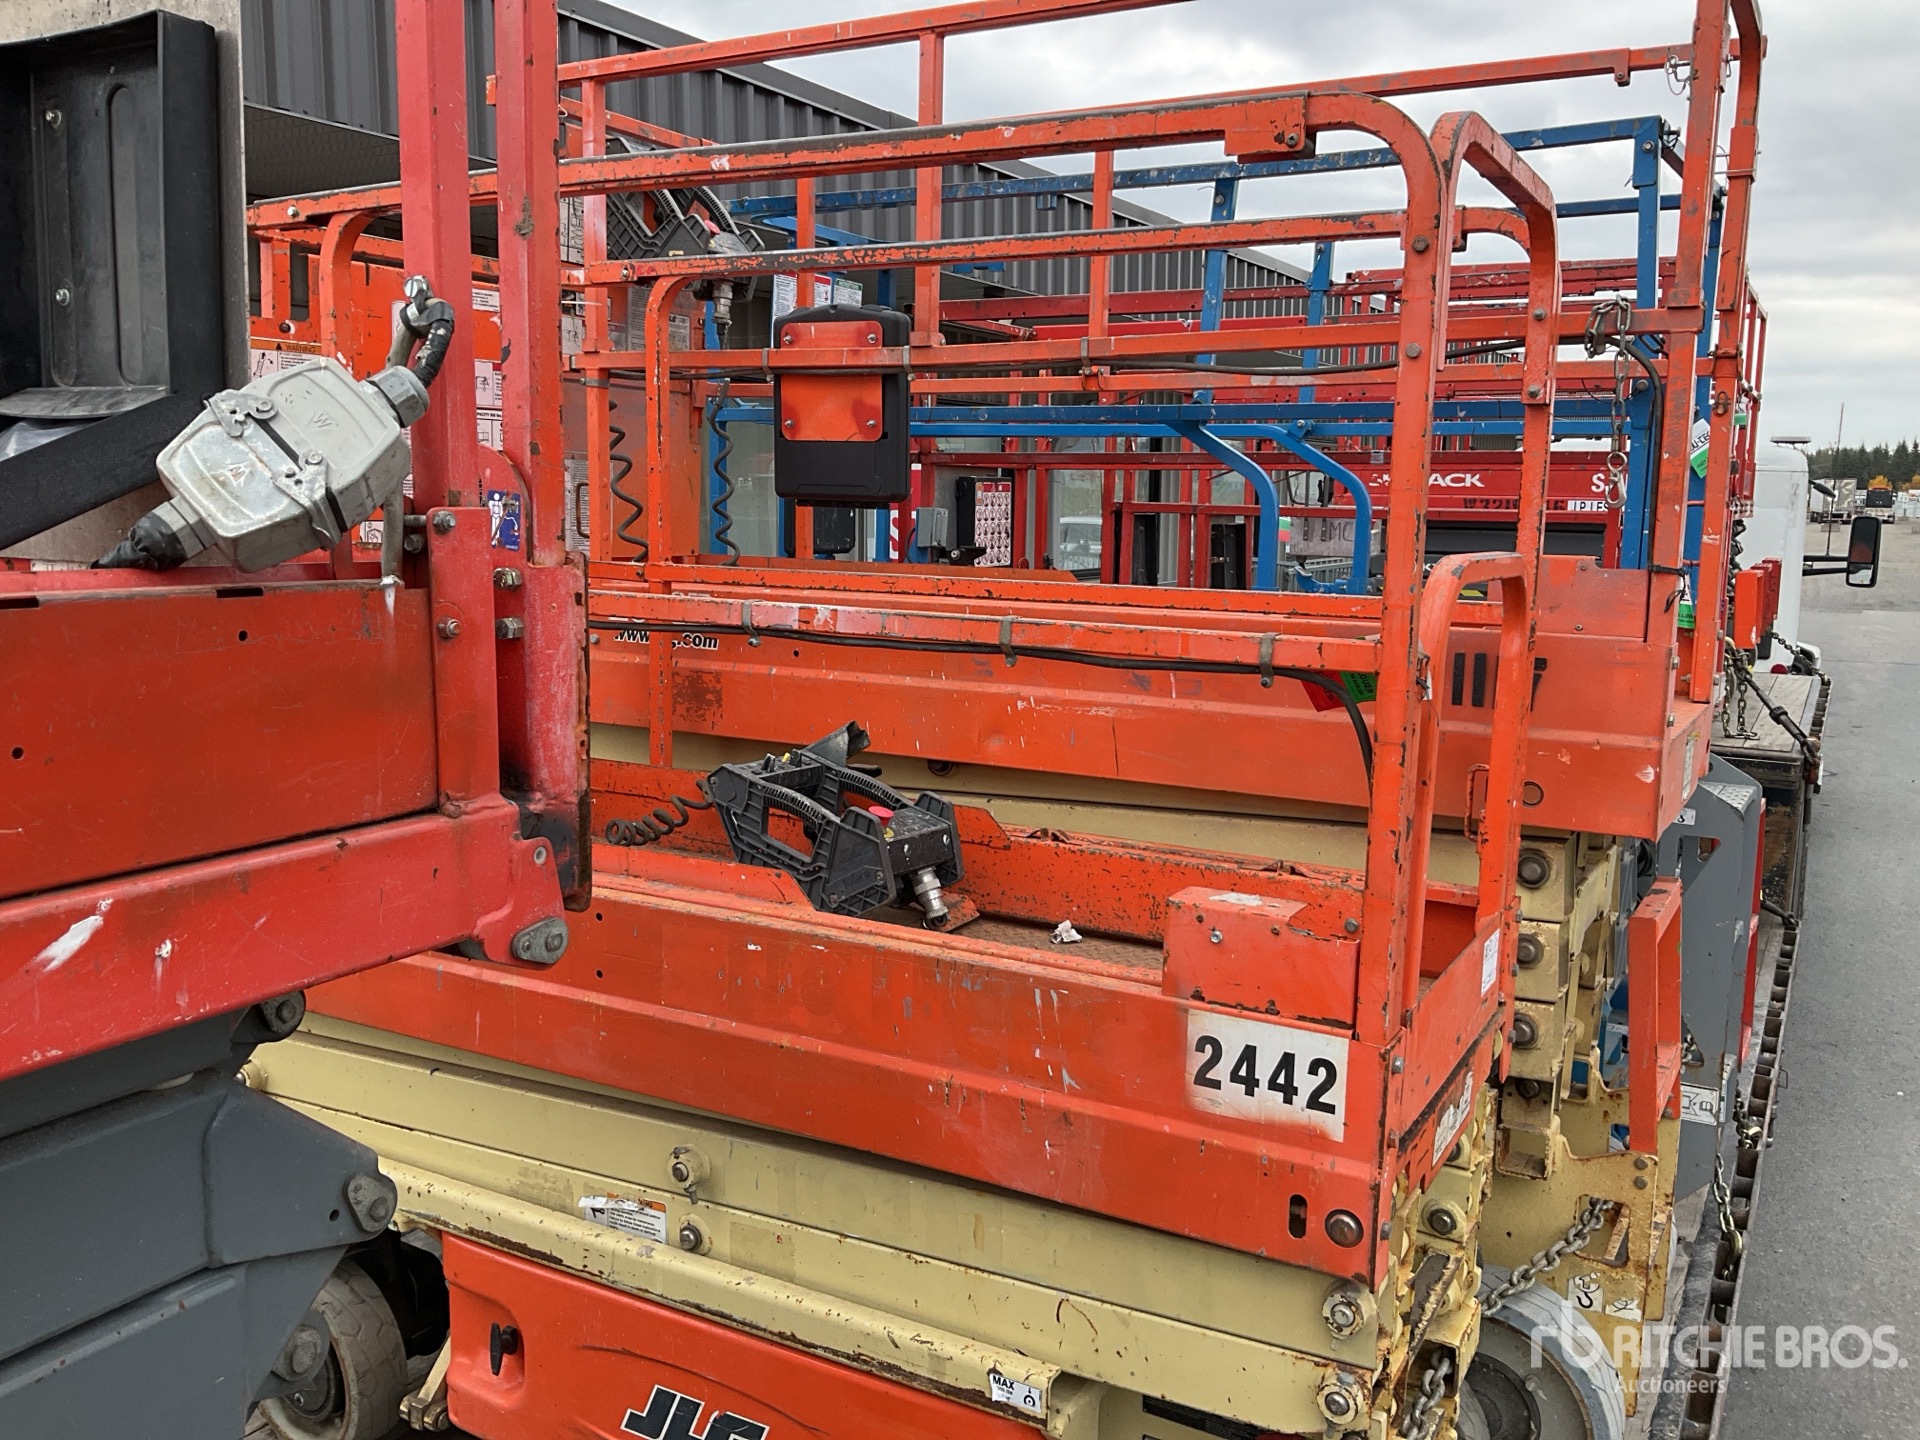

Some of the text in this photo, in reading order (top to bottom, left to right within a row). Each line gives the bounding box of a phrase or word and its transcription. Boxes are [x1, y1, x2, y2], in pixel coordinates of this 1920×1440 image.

[286, 344, 316, 353] WARNING
[1193, 1035, 1337, 1115] 2442
[993, 1375, 1015, 1391] MAX
